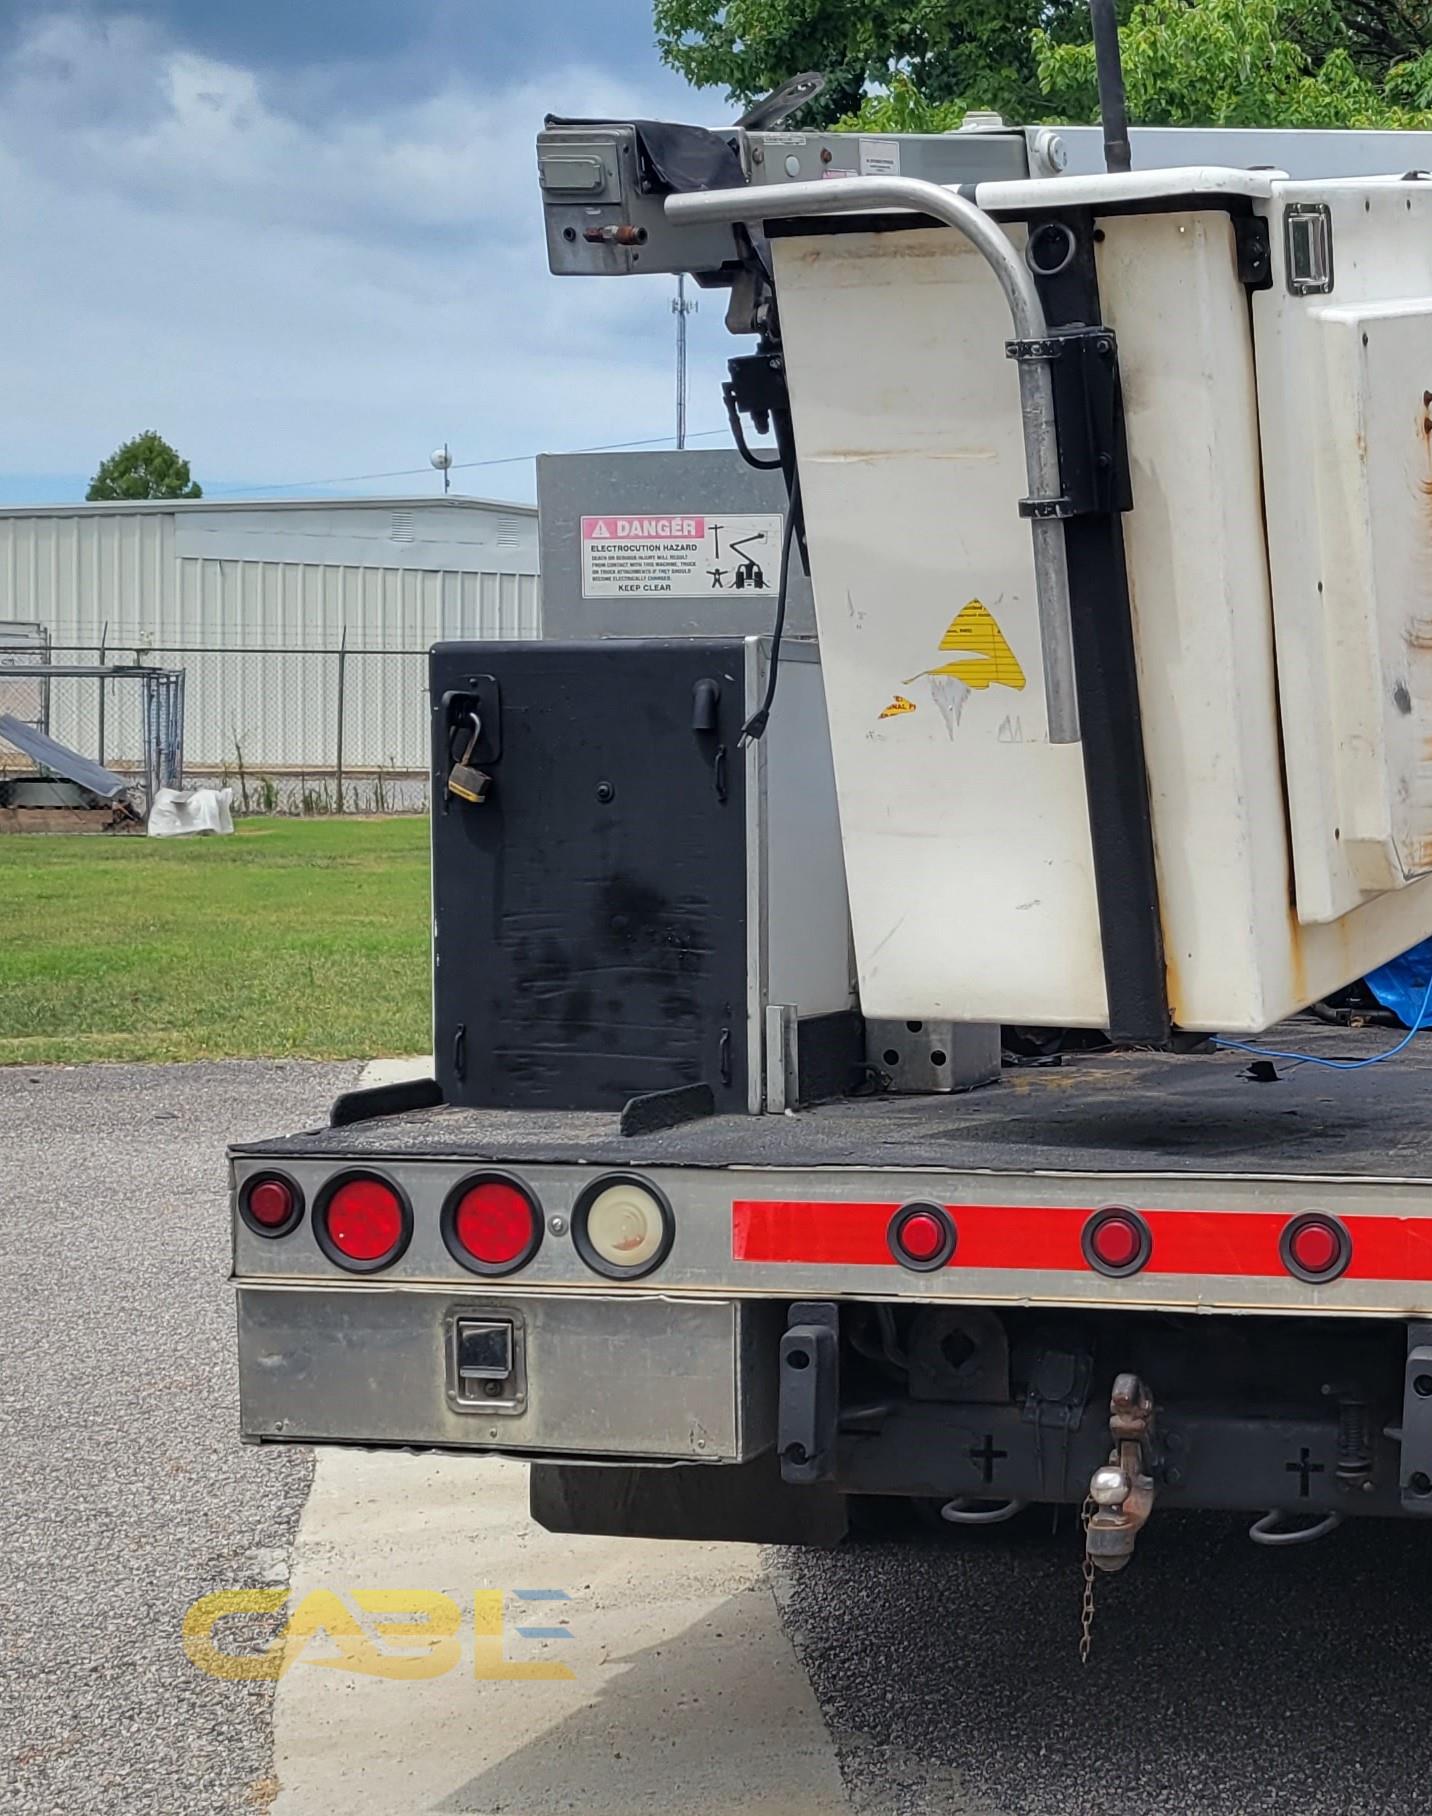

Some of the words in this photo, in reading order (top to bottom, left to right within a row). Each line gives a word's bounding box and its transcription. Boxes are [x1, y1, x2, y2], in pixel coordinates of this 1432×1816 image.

[617, 520, 696, 536] DANGER
[591, 544, 661, 552] ELECTROCUTION
[663, 544, 698, 552] HAZARD
